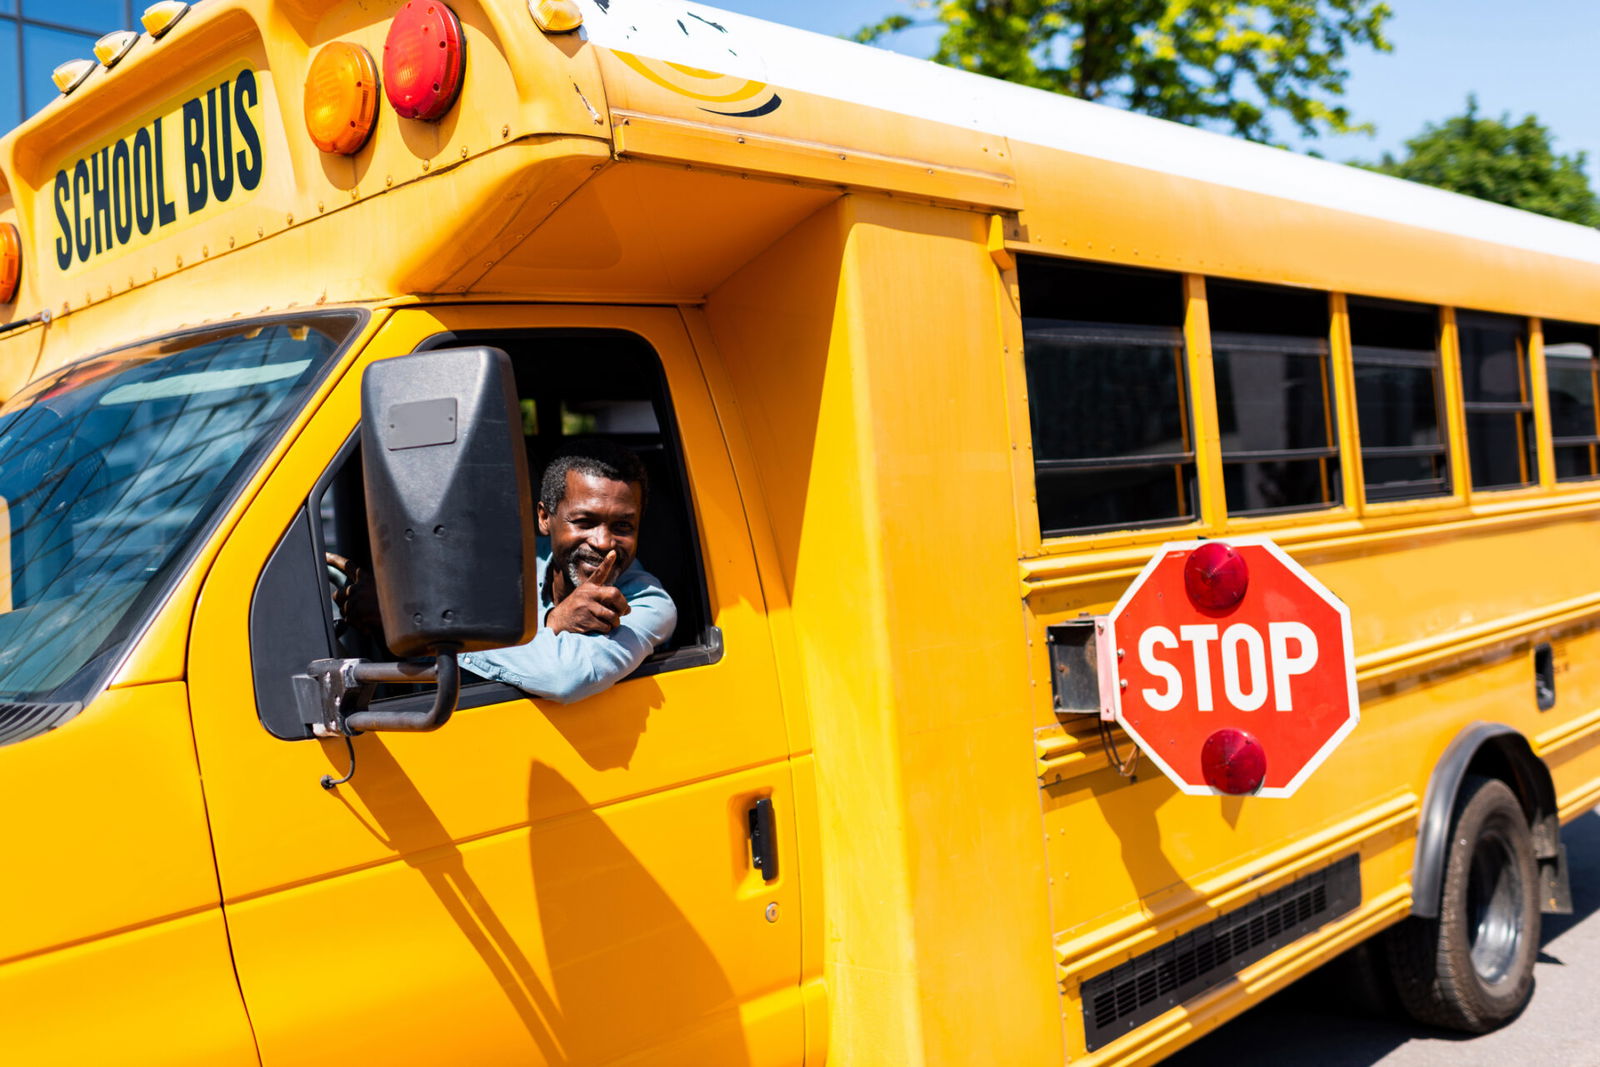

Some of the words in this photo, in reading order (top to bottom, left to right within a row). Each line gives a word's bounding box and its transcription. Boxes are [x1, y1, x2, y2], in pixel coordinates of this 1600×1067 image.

[54, 117, 176, 271] SCHOOL
[182, 69, 262, 214] BUS
[1138, 621, 1319, 712] STOP
